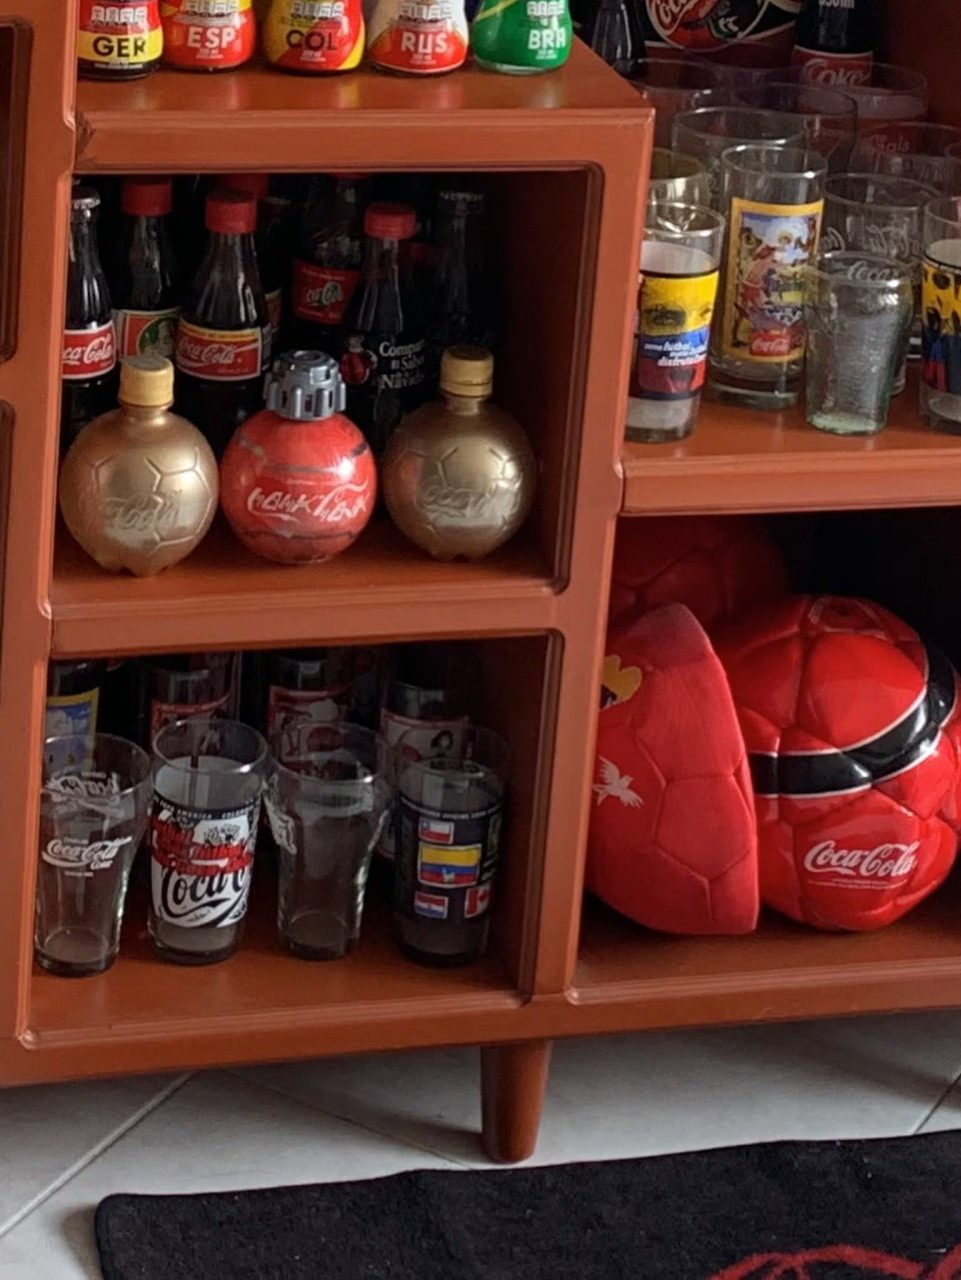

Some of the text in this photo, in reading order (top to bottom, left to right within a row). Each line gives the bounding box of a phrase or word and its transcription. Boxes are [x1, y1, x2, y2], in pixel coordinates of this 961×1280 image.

[92, 35, 147, 58] GER
[187, 27, 237, 49] ESP
[285, 28, 339, 51] COL
[401, 31, 450, 53] RUS
[527, 27, 567, 50] BRA
[805, 839, 918, 879] Coca-Cola
